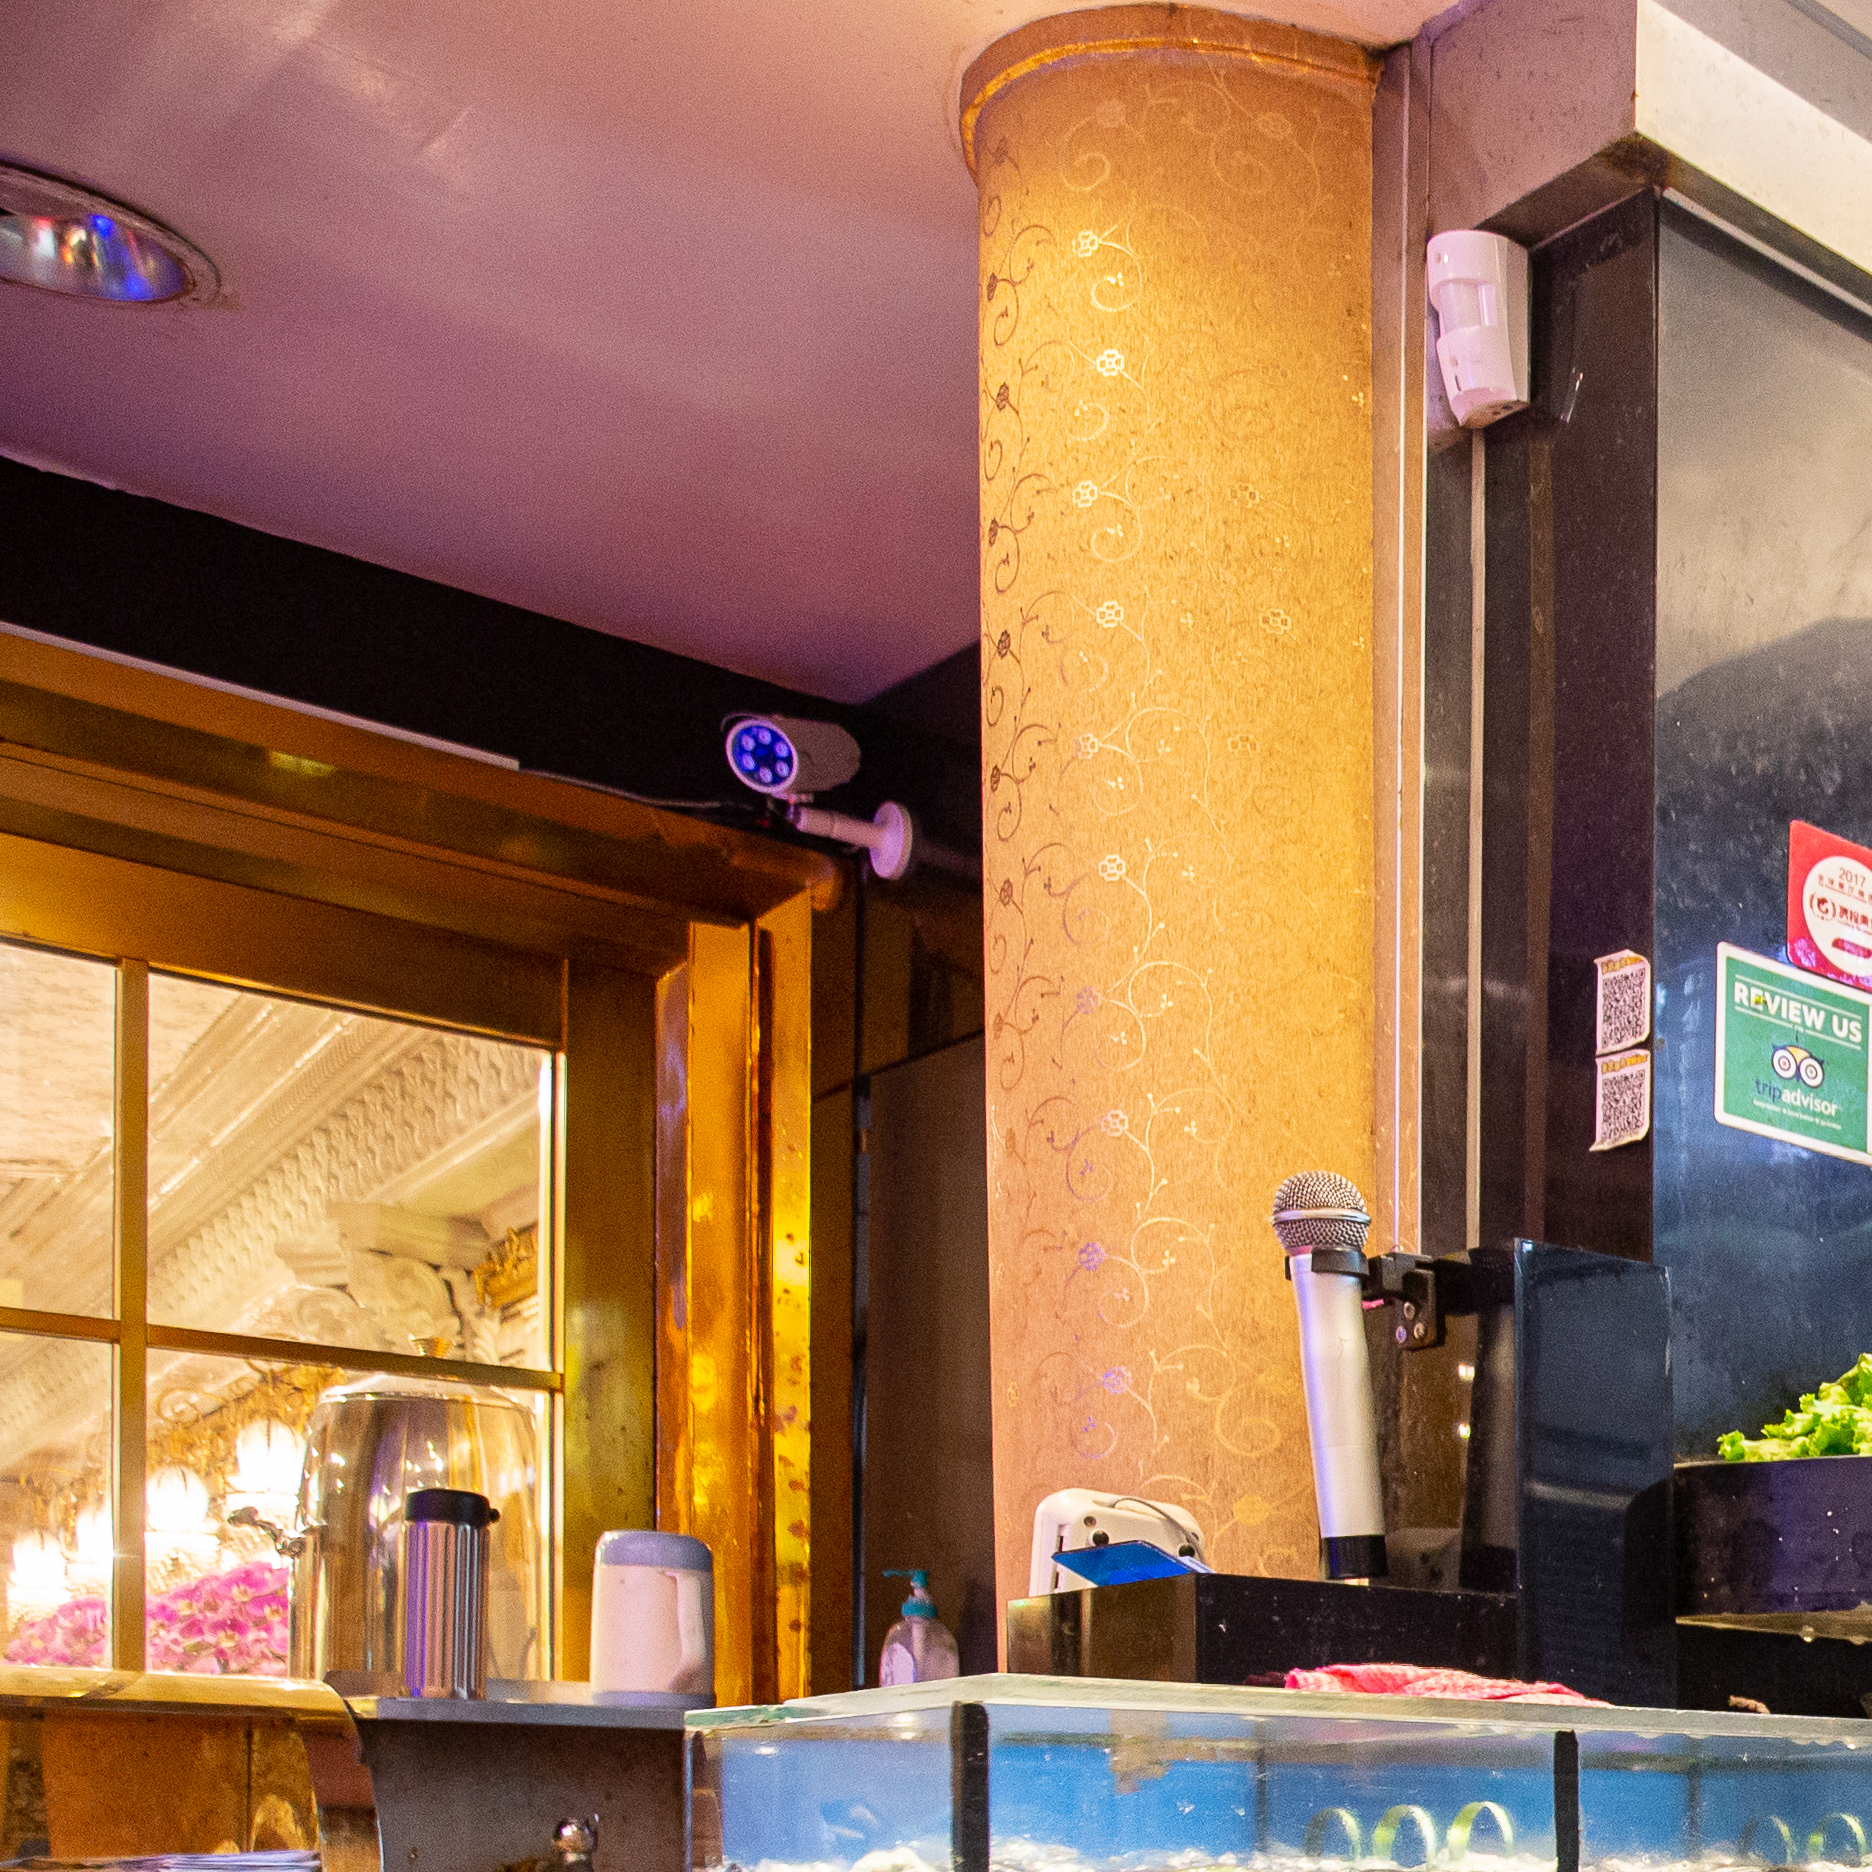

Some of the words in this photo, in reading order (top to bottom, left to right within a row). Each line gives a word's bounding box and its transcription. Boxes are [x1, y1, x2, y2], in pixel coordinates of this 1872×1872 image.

[1838, 866, 1867, 887] 2017
[1733, 981, 1826, 1030] REVIEW
[1831, 1013, 1863, 1043] US
[1754, 1077, 1841, 1118] tripadvisor
